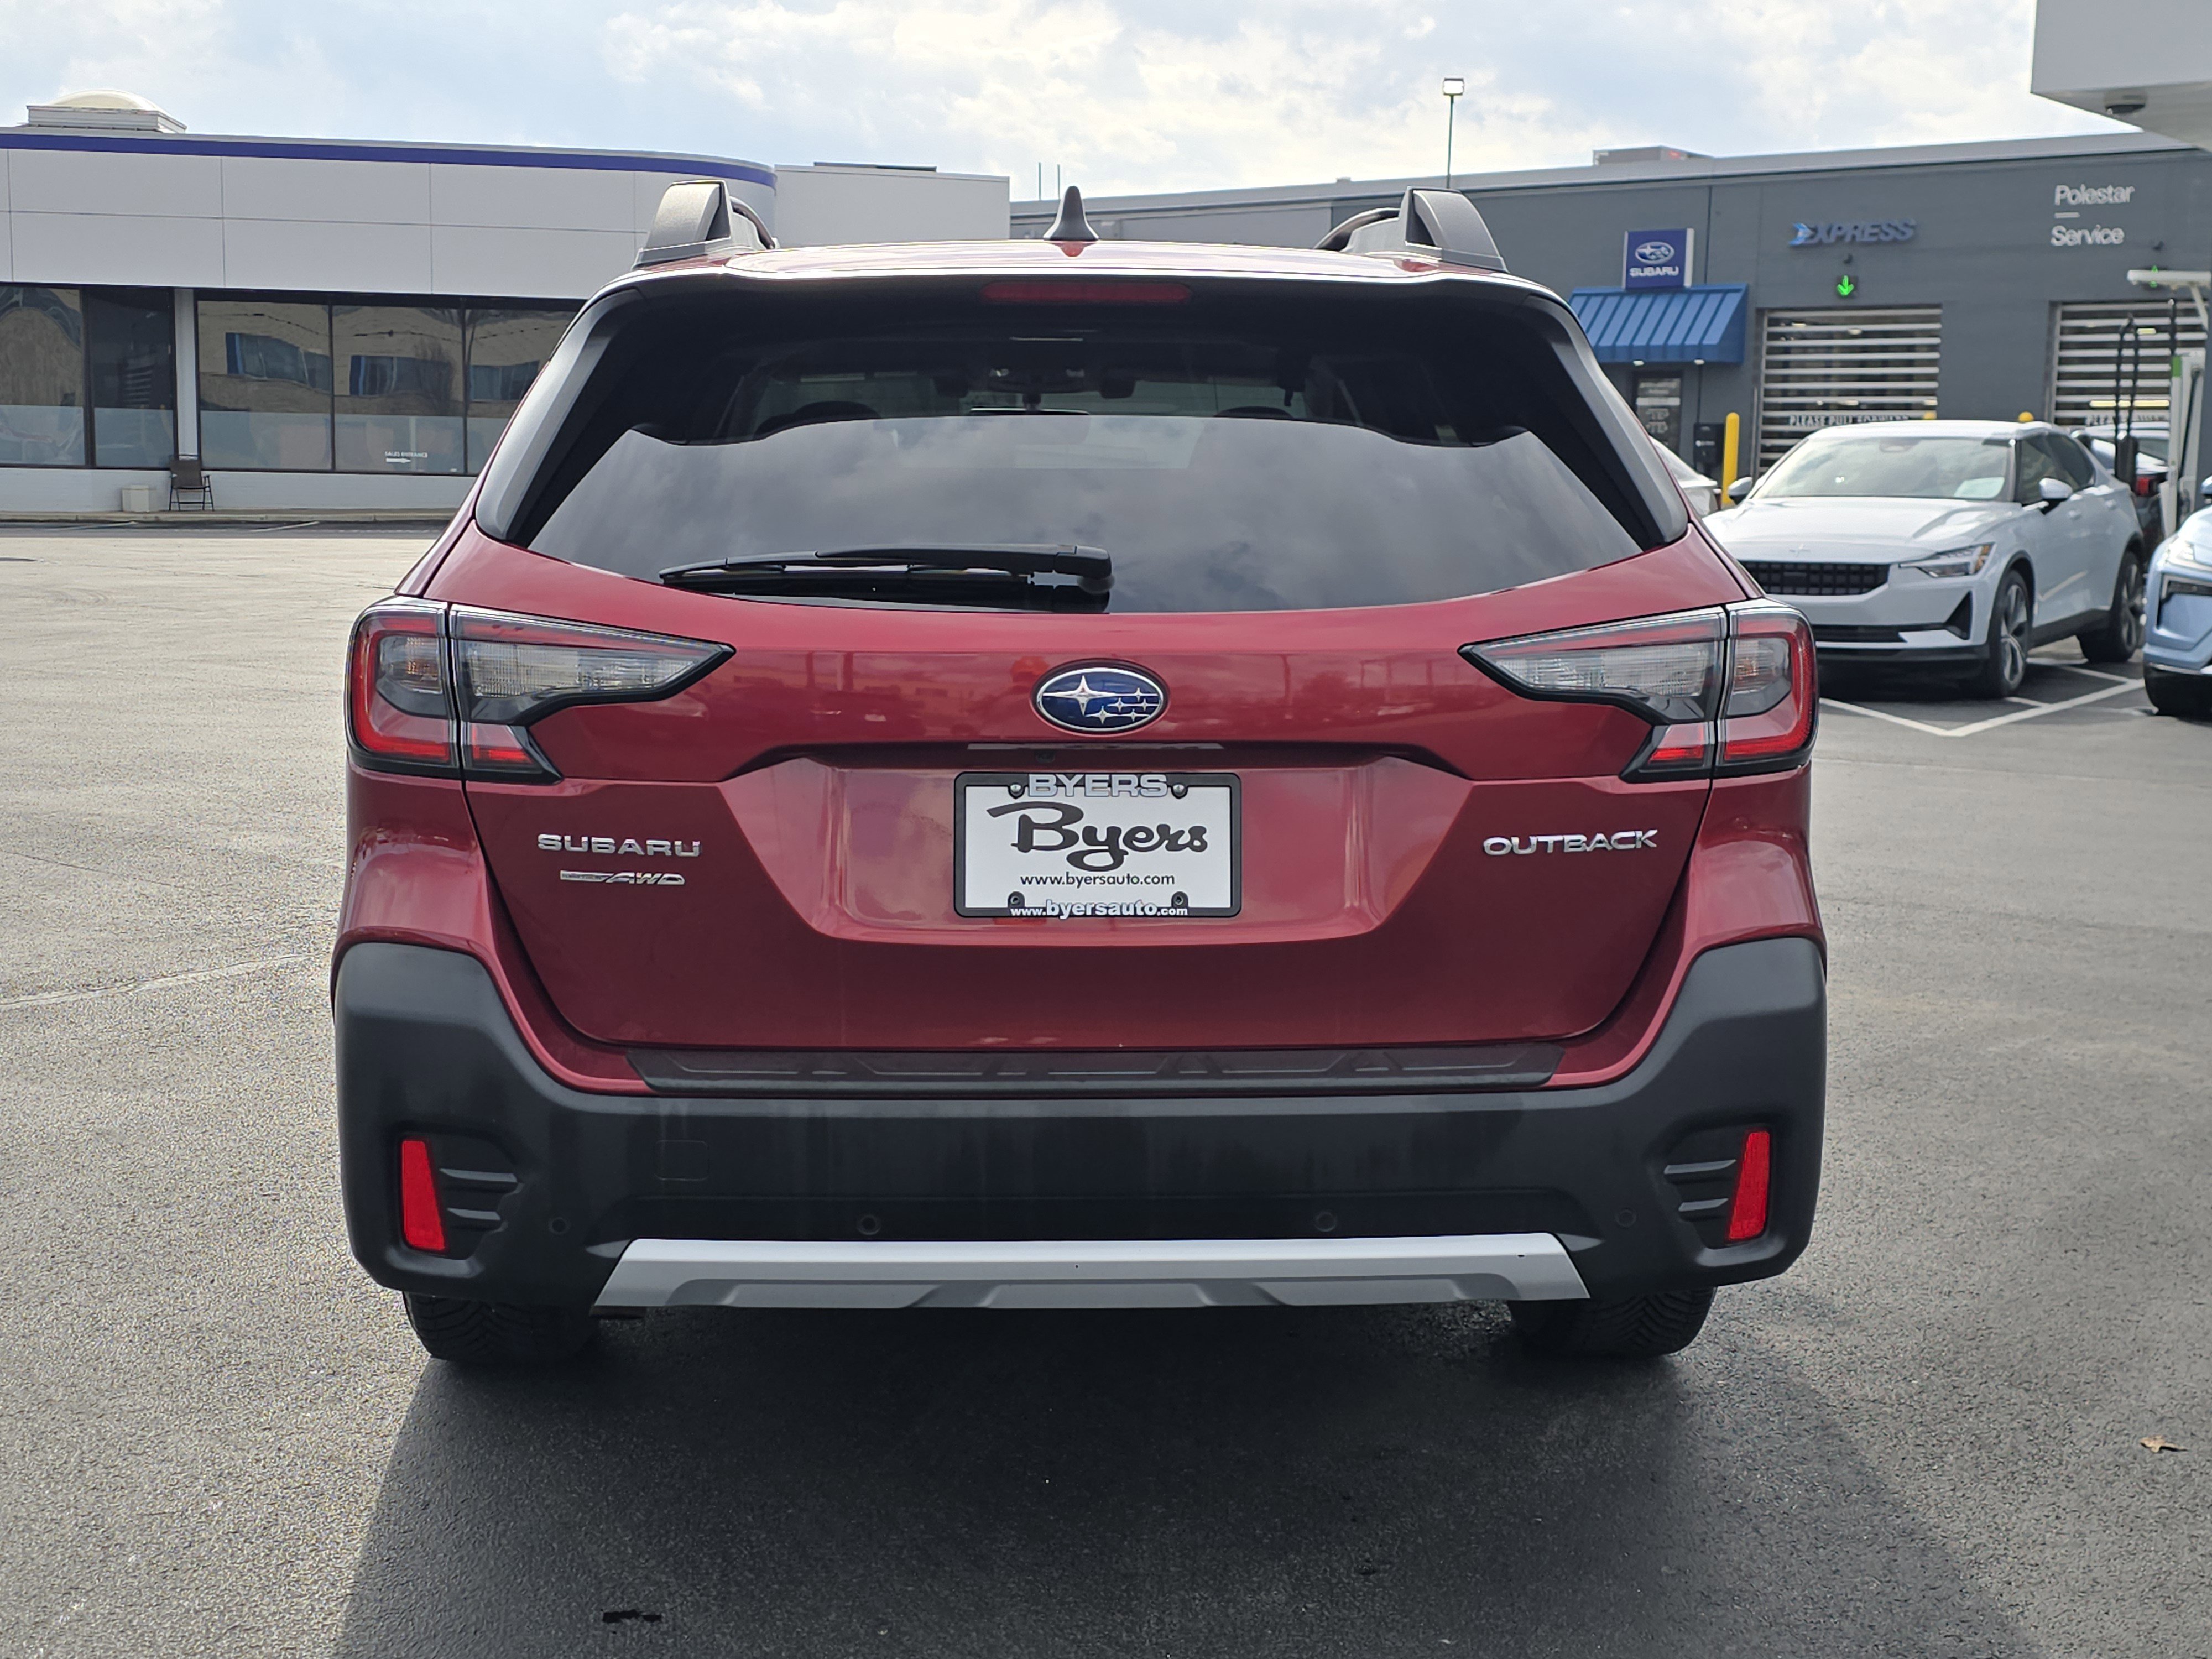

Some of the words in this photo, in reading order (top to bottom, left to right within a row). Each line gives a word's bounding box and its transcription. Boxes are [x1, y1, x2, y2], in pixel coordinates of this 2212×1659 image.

[2054, 184, 2135, 206] Polestar
[1789, 220, 1916, 245] EXPRESS
[2051, 224, 2125, 246] Service
[1629, 266, 1679, 277] SUBARU
[1790, 415, 1825, 426] PLEASE
[1027, 774, 1168, 797] BYERS
[538, 833, 701, 857] SUBARU
[986, 801, 1208, 872] Byers
[1483, 829, 1658, 855] OUTBACK
[605, 872, 685, 885] AWD
[1020, 871, 1175, 889] www.byersauto.com
[1010, 899, 1188, 920] www.byersauto.com
